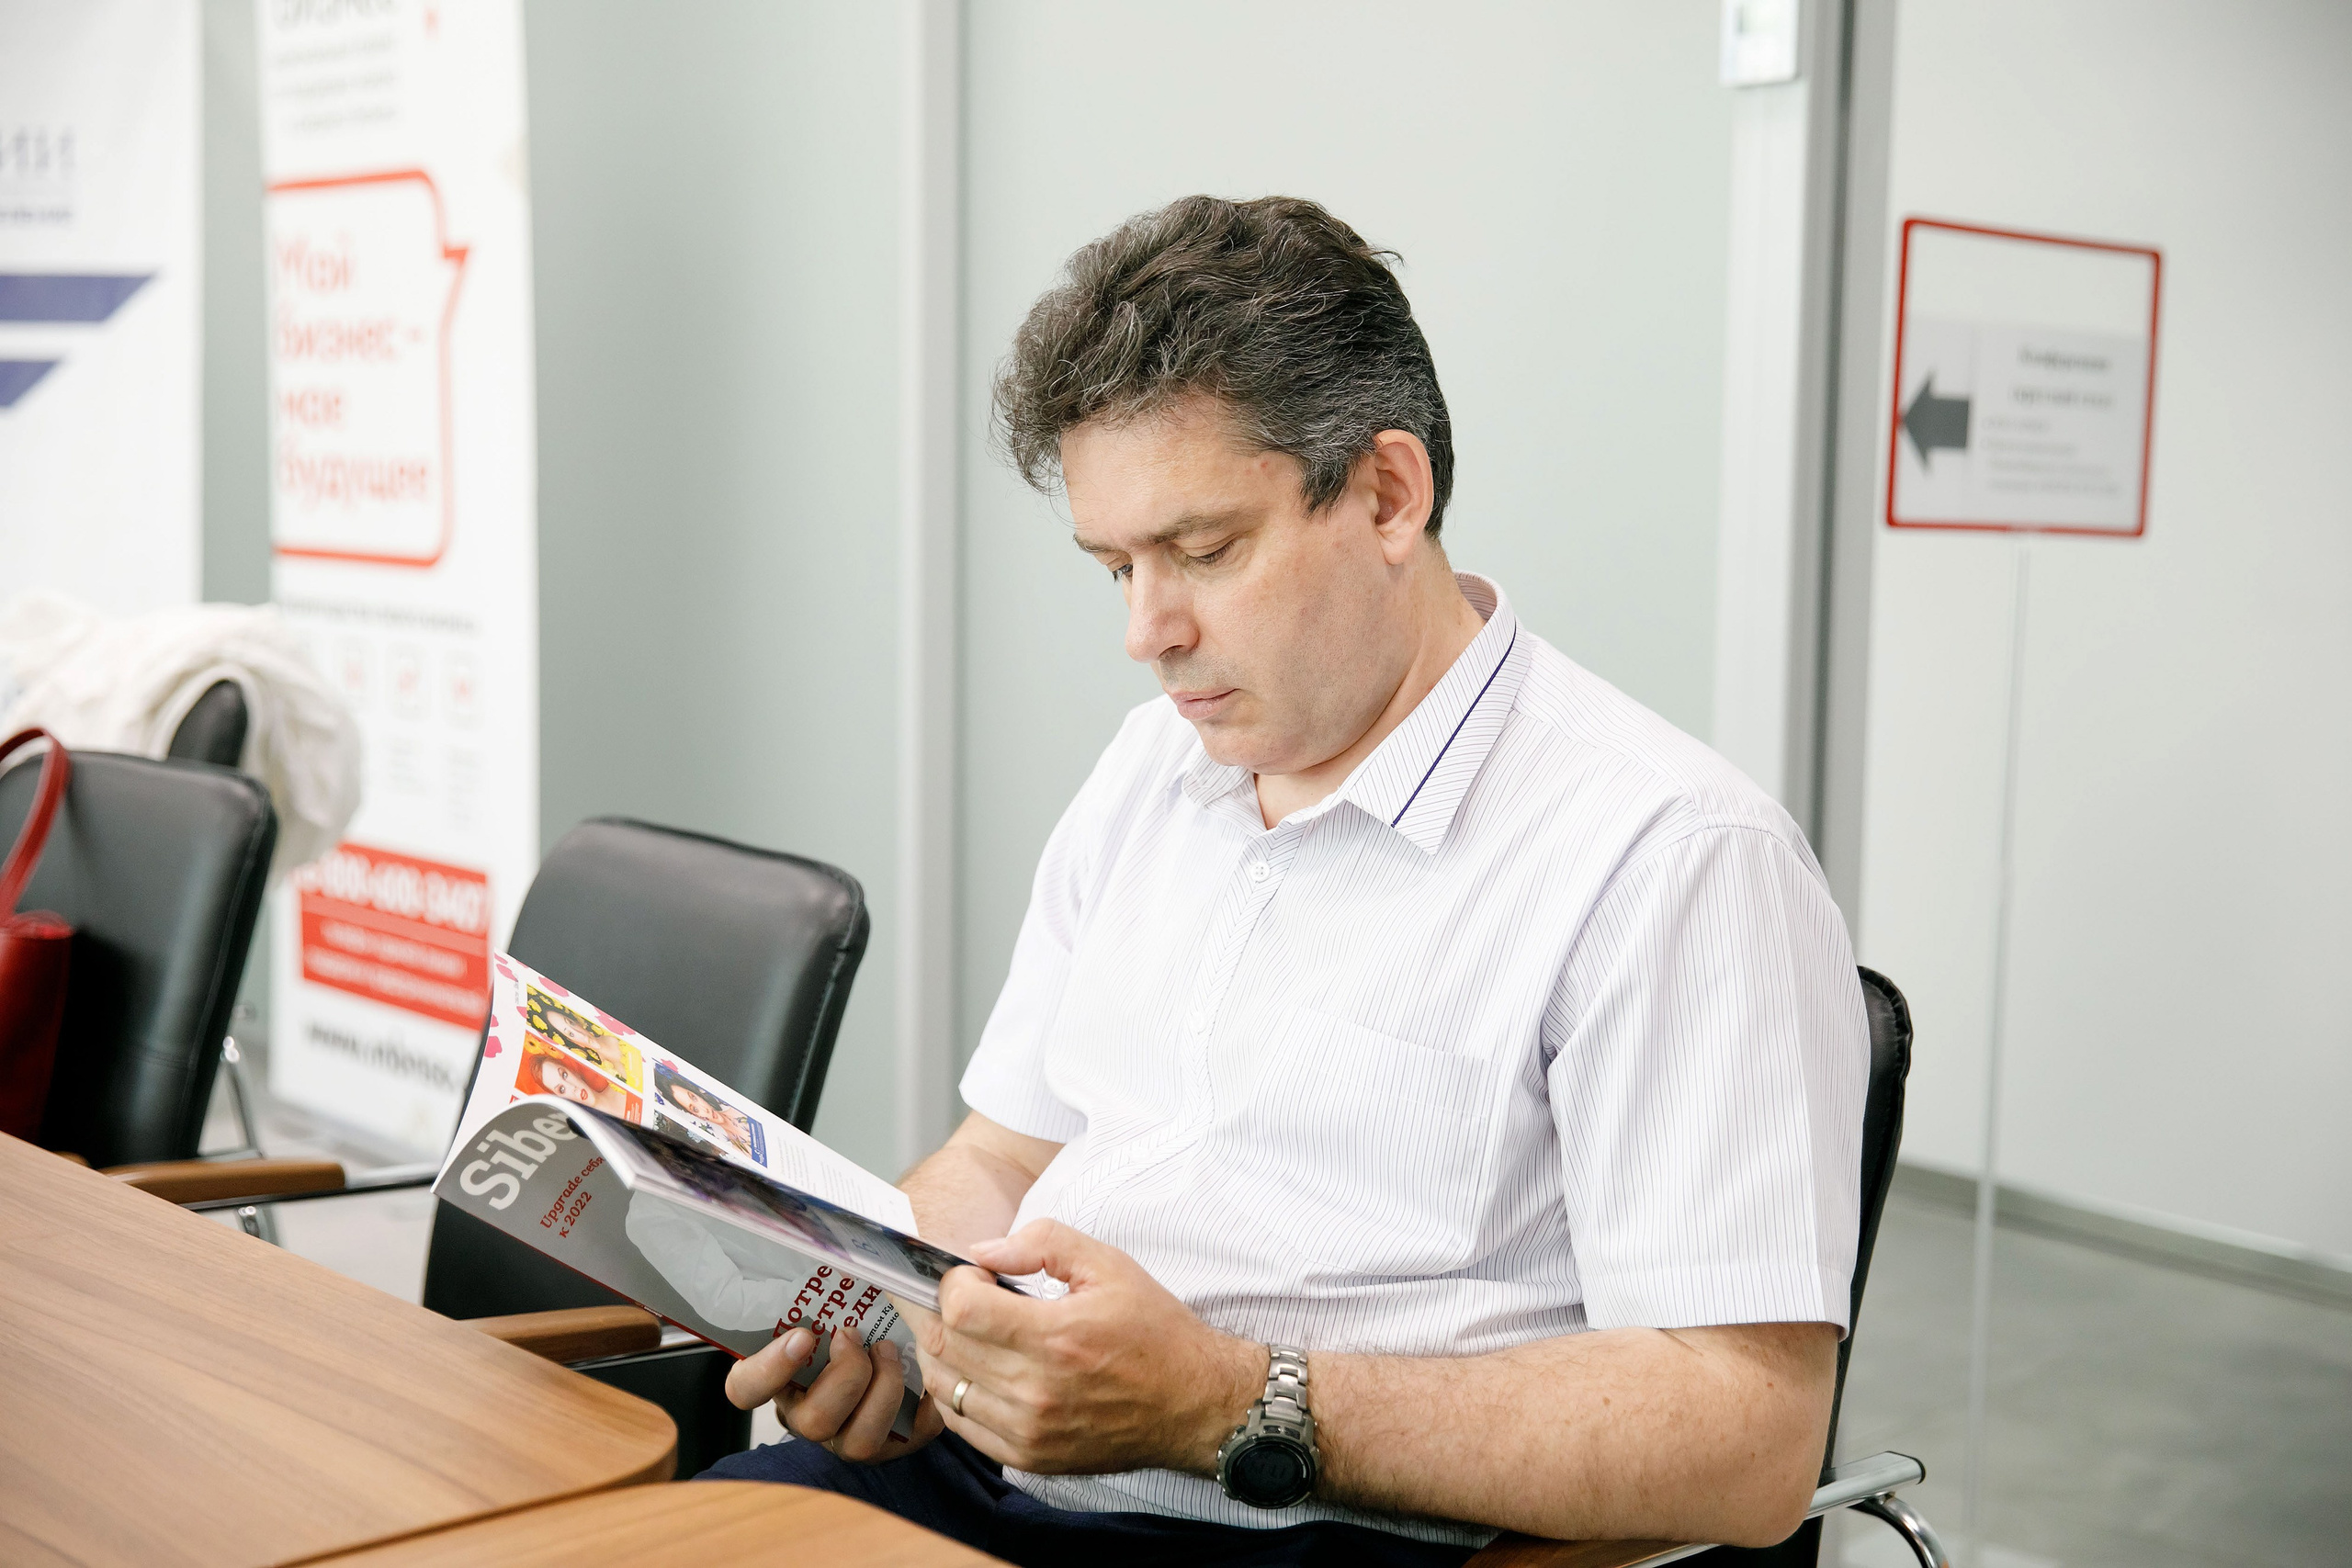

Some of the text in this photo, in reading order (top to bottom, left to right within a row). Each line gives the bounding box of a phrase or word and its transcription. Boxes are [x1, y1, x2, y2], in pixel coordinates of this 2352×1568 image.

[540, 1156, 605, 1229] Upgrade себя
[564, 1190, 593, 1226] 2022
[773, 1265, 833, 1338] Потре
